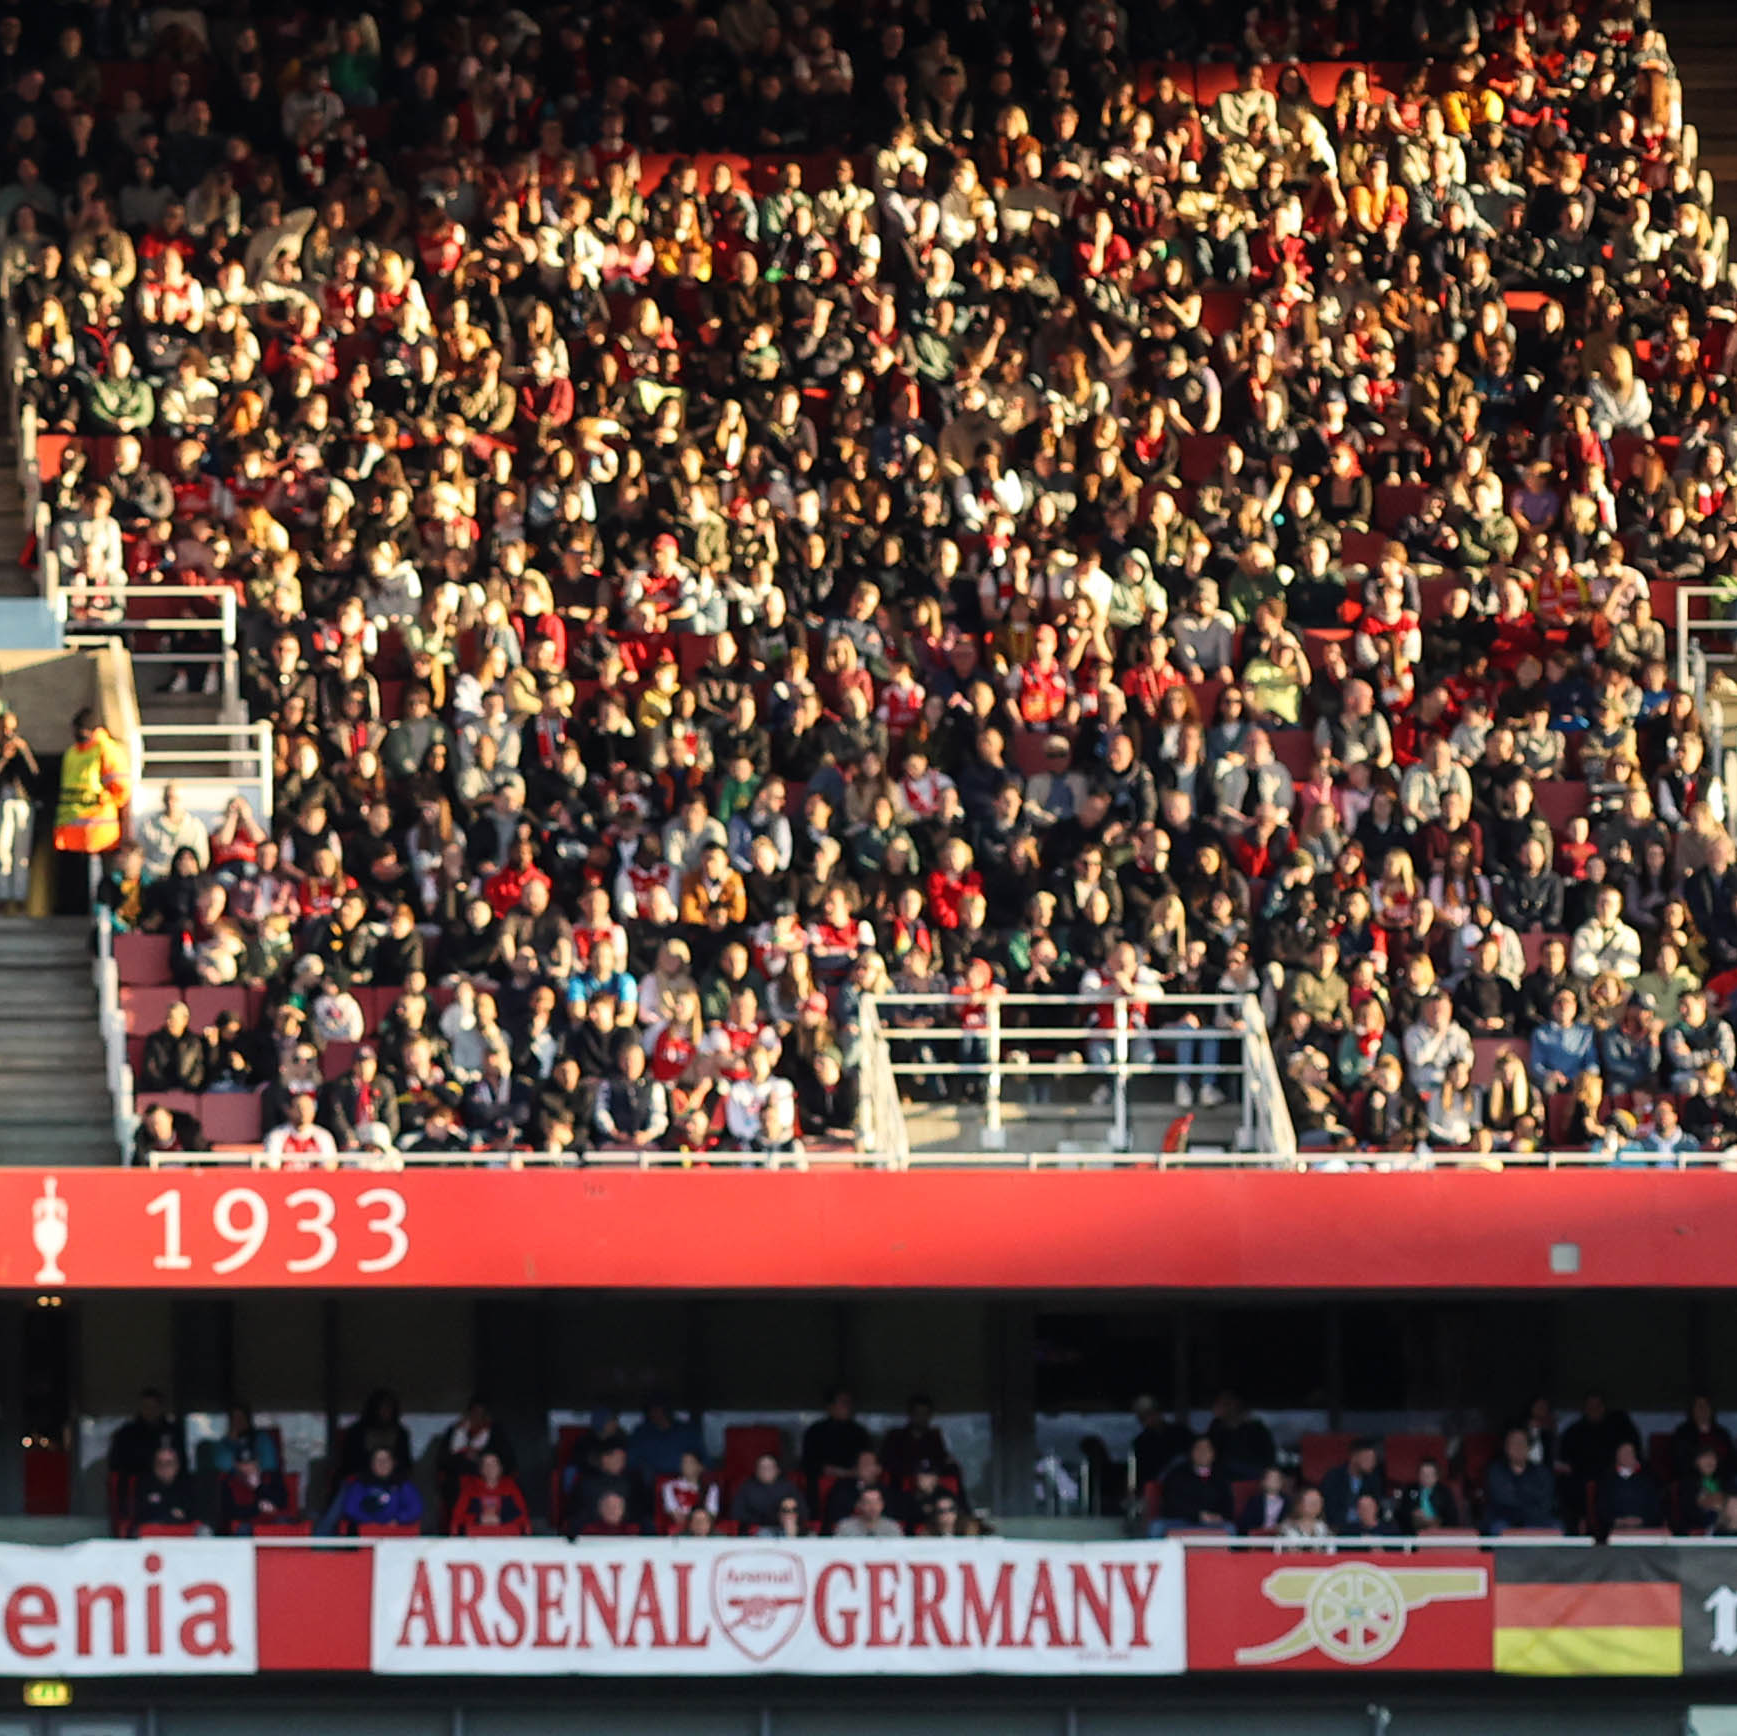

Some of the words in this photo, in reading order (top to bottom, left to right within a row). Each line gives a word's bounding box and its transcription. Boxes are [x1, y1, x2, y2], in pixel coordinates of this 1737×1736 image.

[145, 1187, 409, 1275] 1933
[395, 1560, 711, 1648] ARSENAL
[813, 1560, 1163, 1649] GERMANY
